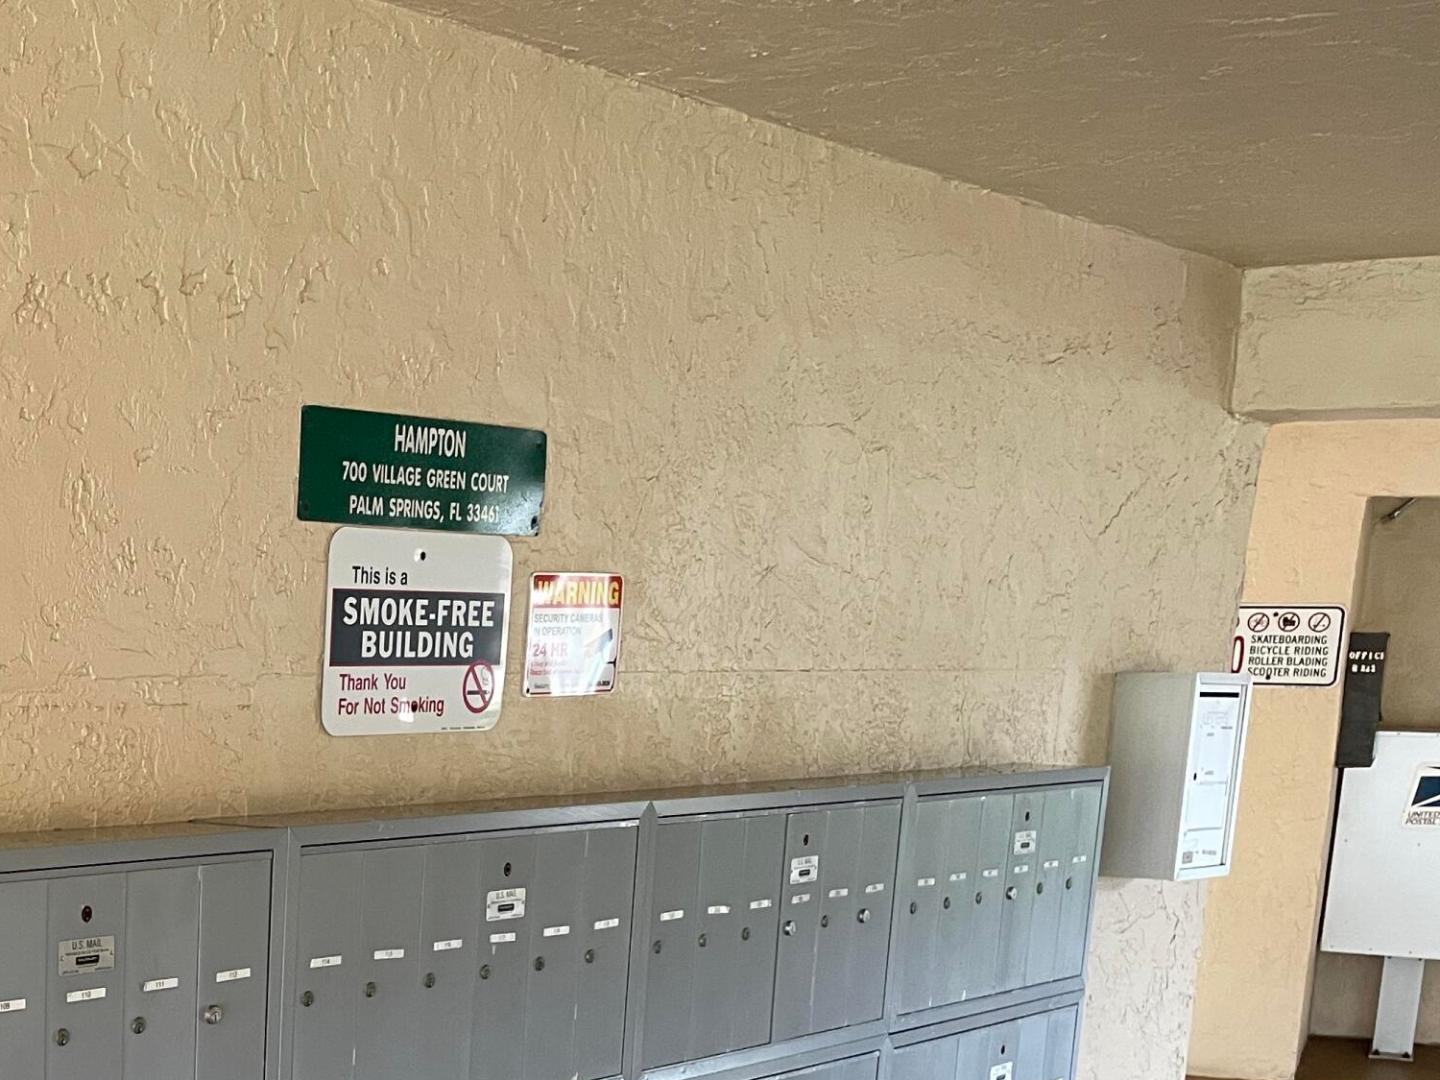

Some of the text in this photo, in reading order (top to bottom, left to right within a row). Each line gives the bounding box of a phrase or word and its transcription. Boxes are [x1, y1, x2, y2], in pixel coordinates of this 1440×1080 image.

[394, 424, 467, 458] HAMPTON
[342, 461, 509, 493] 700 VILLAGE GREEN COURT
[349, 495, 500, 523] PALM SPRINGS, FL 33461
[352, 566, 408, 585] This is a
[536, 580, 620, 606] WARNING
[343, 596, 495, 627] SMOKE-FREE
[534, 613, 569, 623] SECURITY
[361, 630, 474, 658] BUILDING
[1250, 634, 1328, 645] SKATEBOARDING
[532, 643, 547, 657] 24
[1249, 645, 1329, 656] BICYCLE RIDING
[1248, 656, 1328, 666] ROLLER BLADING
[1247, 666, 1327, 677] SCOOTER RIDING
[339, 673, 406, 691] Thank You
[338, 698, 359, 715] For
[363, 698, 386, 714] Not
